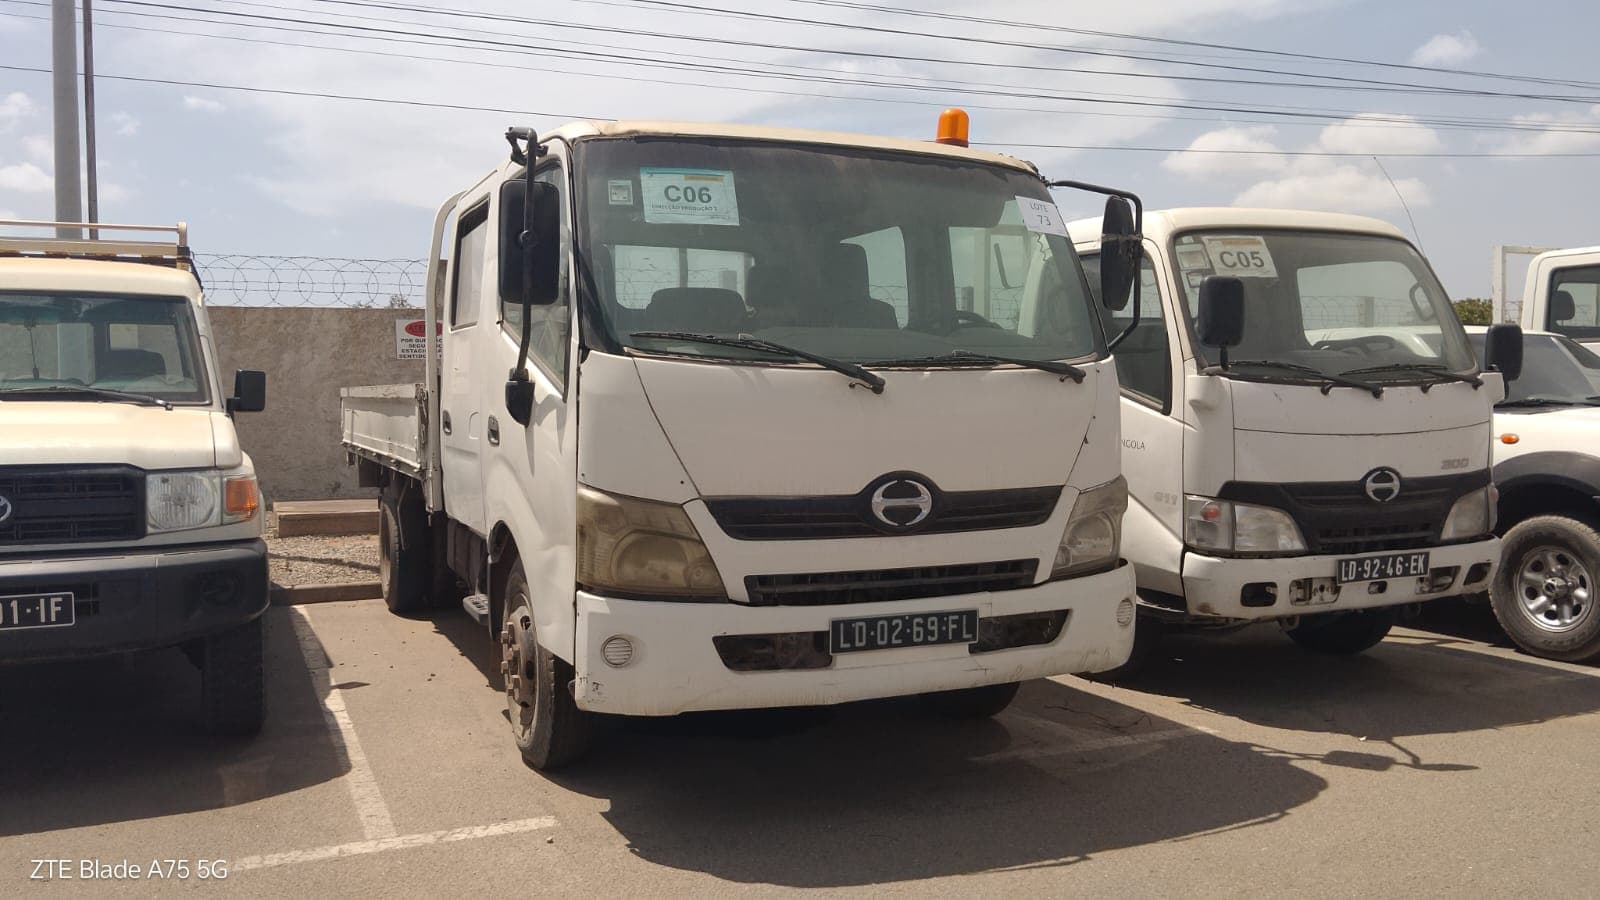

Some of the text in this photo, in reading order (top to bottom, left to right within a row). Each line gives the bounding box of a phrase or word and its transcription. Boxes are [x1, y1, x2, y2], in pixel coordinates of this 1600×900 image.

[664, 185, 712, 203] C06
[1030, 202, 1048, 212] LOTE
[1037, 214, 1051, 226] 73
[1220, 251, 1265, 268] C05
[1121, 439, 1146, 450] NGOLA
